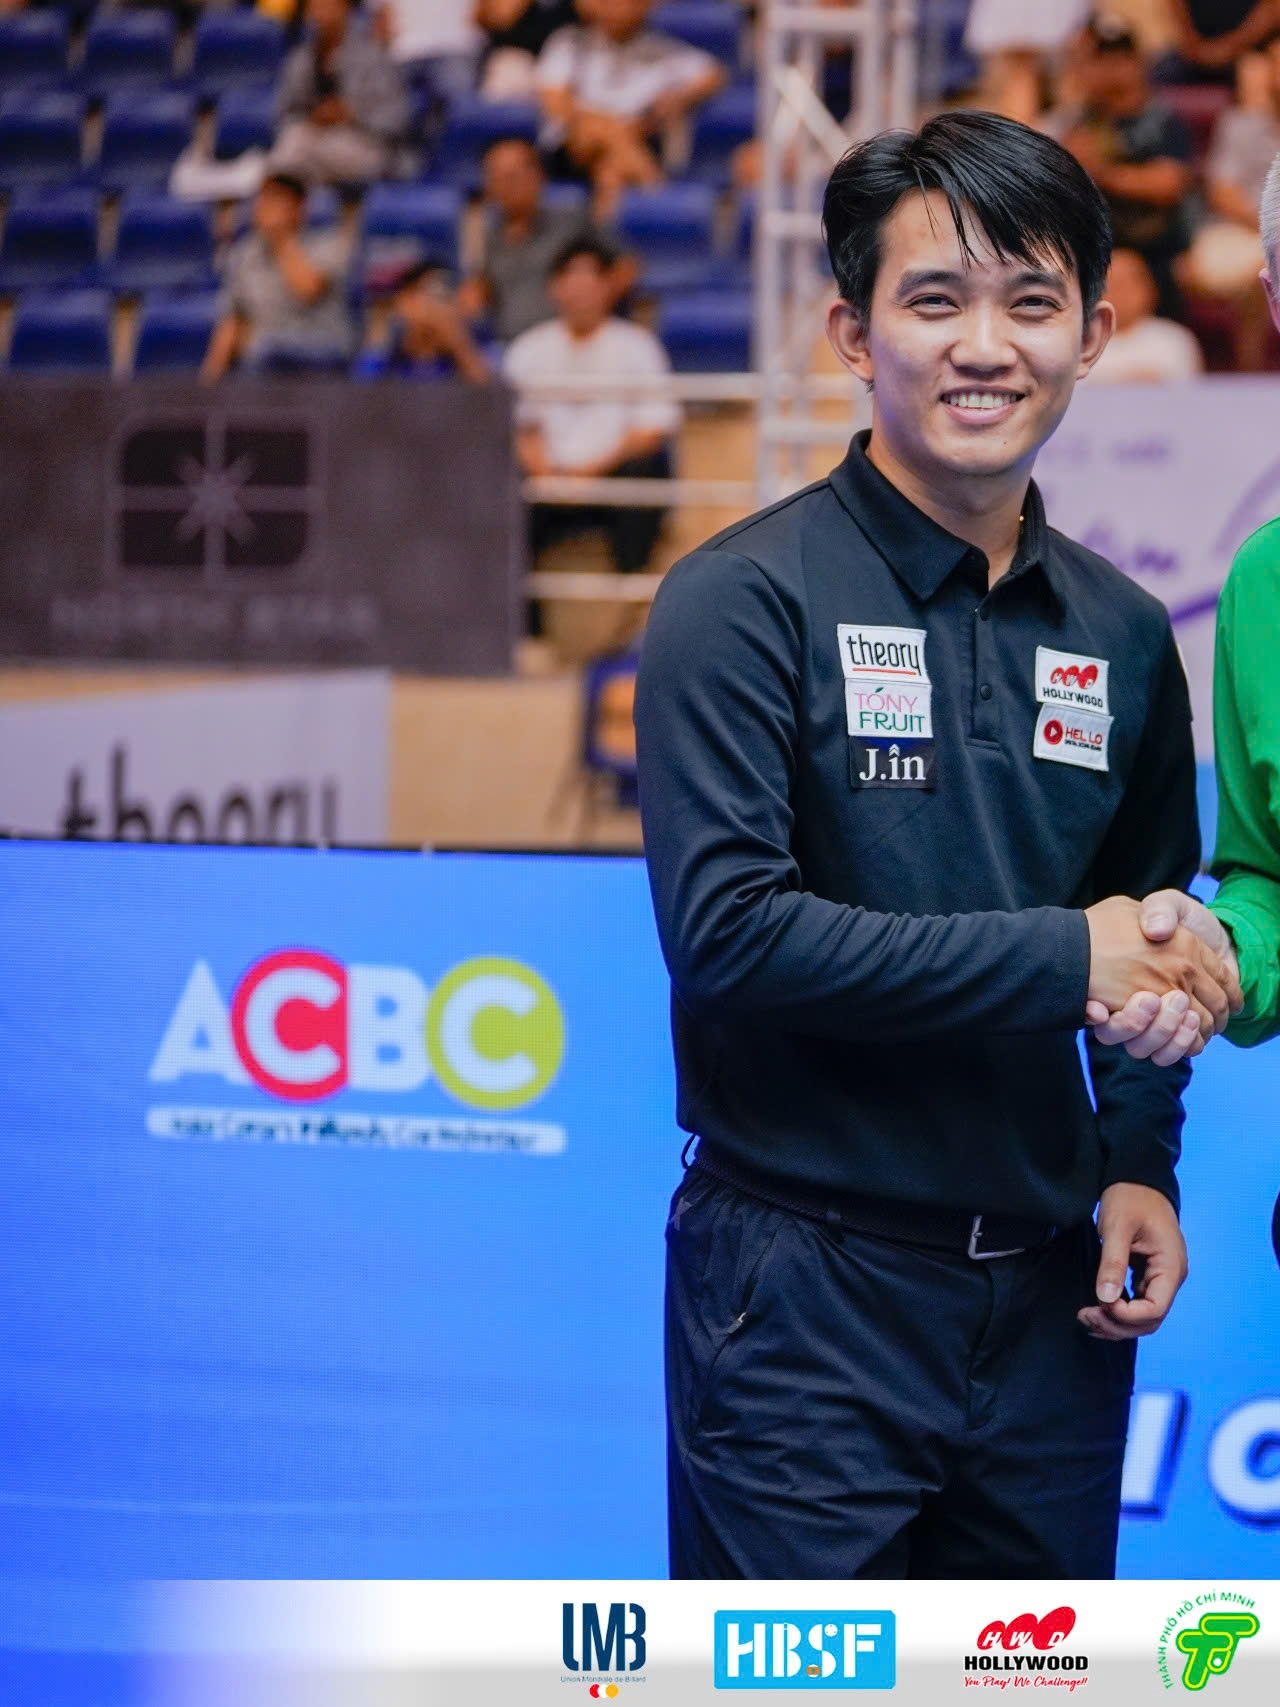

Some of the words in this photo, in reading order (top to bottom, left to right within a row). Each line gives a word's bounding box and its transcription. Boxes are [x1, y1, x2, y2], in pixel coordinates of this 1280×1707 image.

[846, 633, 922, 676] theory
[1042, 687, 1104, 708] HOLLYWOOD
[859, 711, 926, 733] FRUIT
[148, 956, 540, 1096] ACBC
